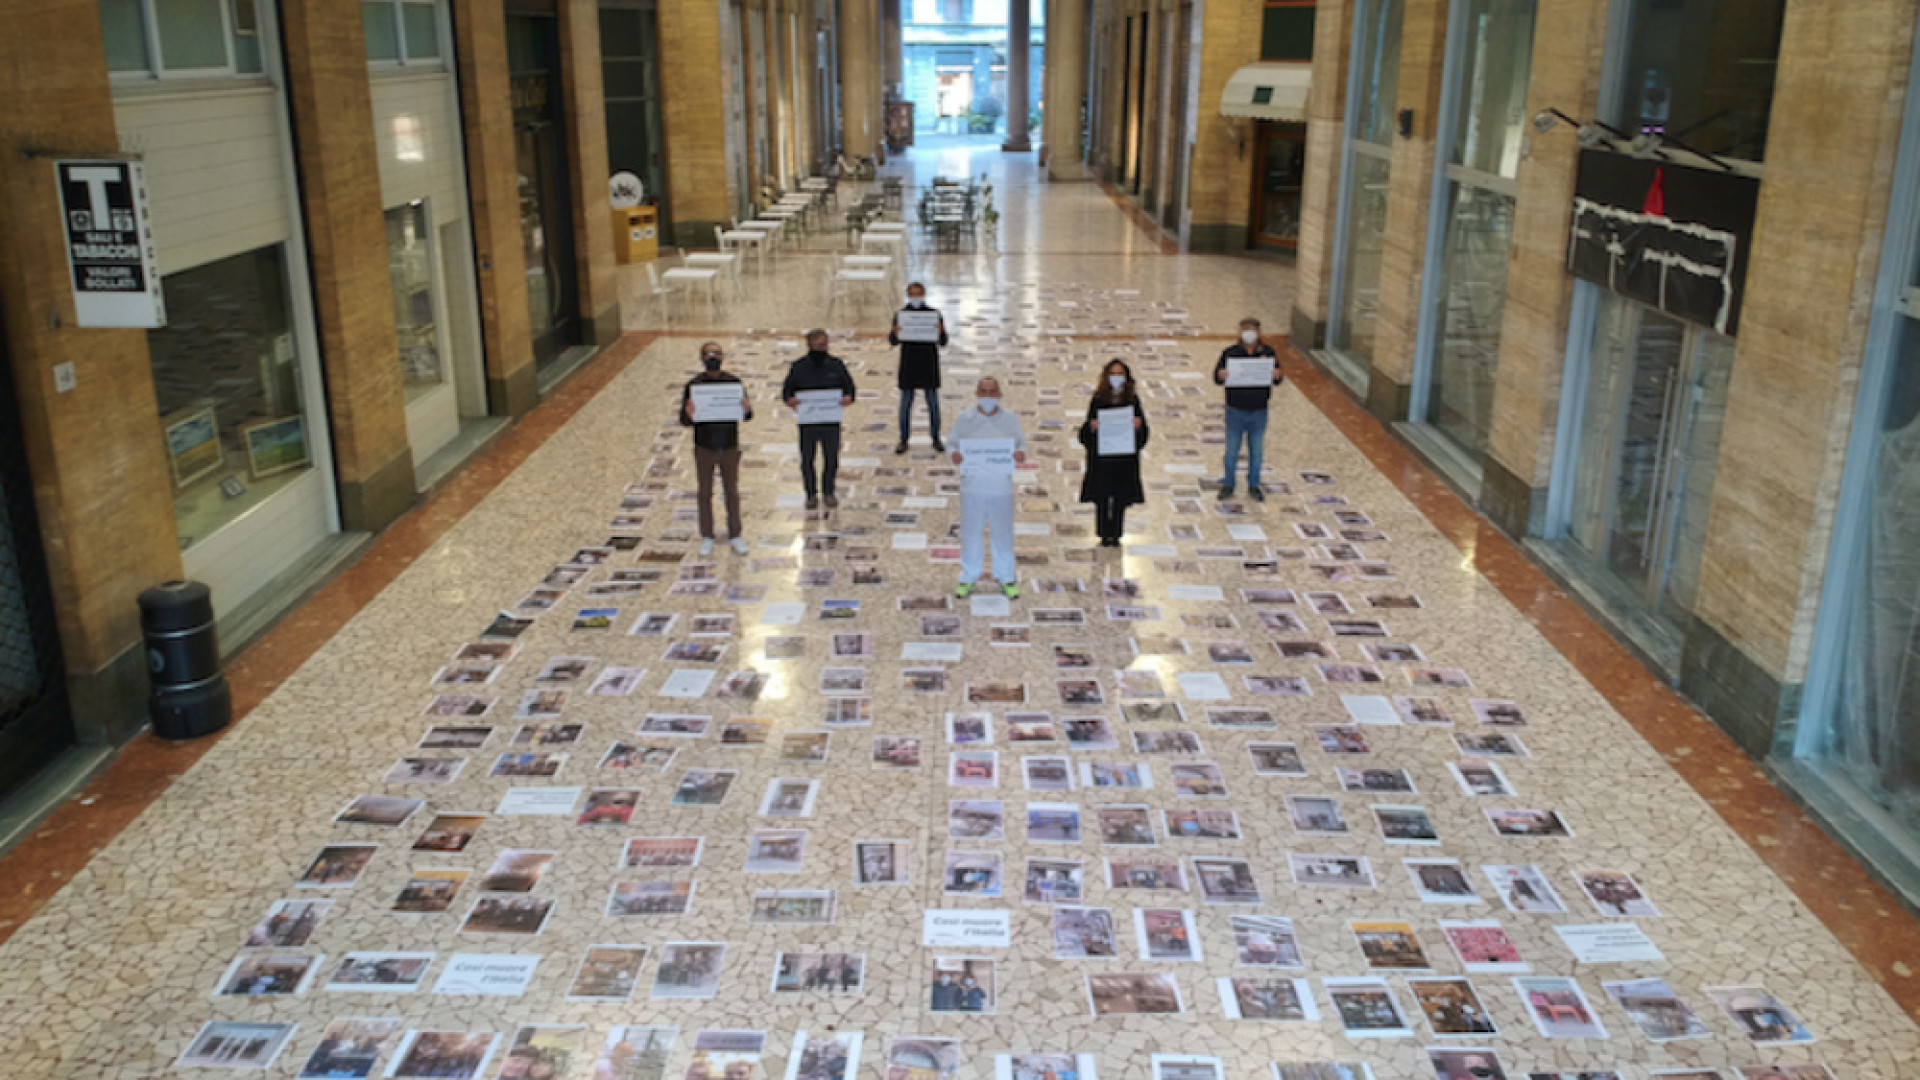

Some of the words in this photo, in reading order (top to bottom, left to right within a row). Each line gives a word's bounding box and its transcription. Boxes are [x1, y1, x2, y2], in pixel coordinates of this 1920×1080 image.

[68, 166, 122, 231] T
[72, 244, 139, 258] TABACCHI
[962, 918, 1002, 926] muore
[484, 964, 528, 972] muore
